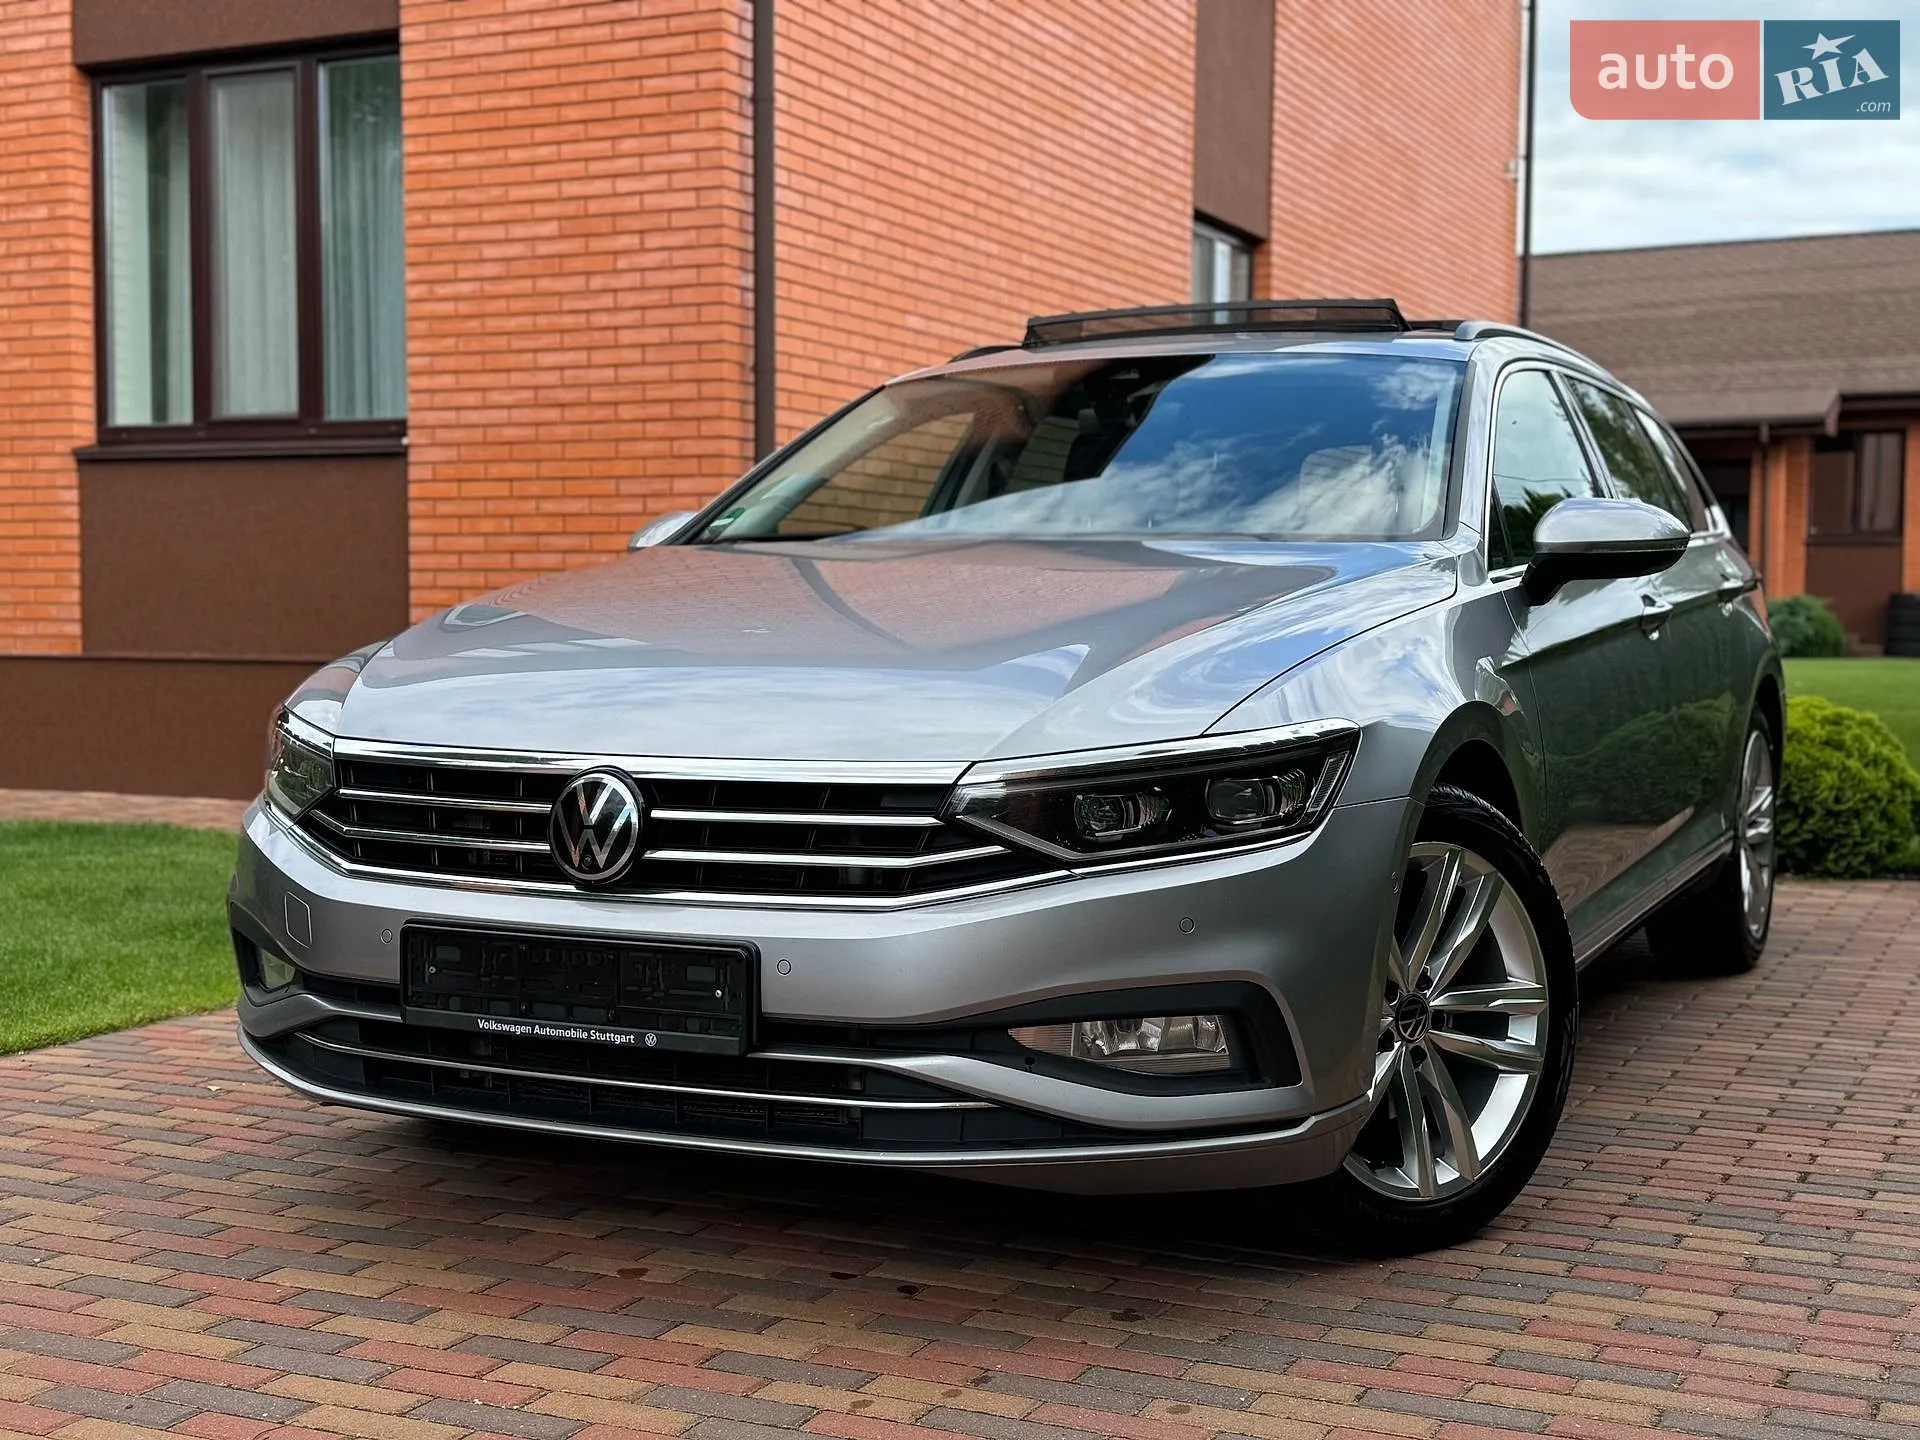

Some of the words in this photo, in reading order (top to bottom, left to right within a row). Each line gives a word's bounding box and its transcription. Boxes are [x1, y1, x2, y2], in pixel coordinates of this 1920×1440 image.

[477, 1018, 532, 1035] Volkswagen
[533, 1024, 588, 1040] Automobile
[590, 1029, 635, 1044] Stuttgart
